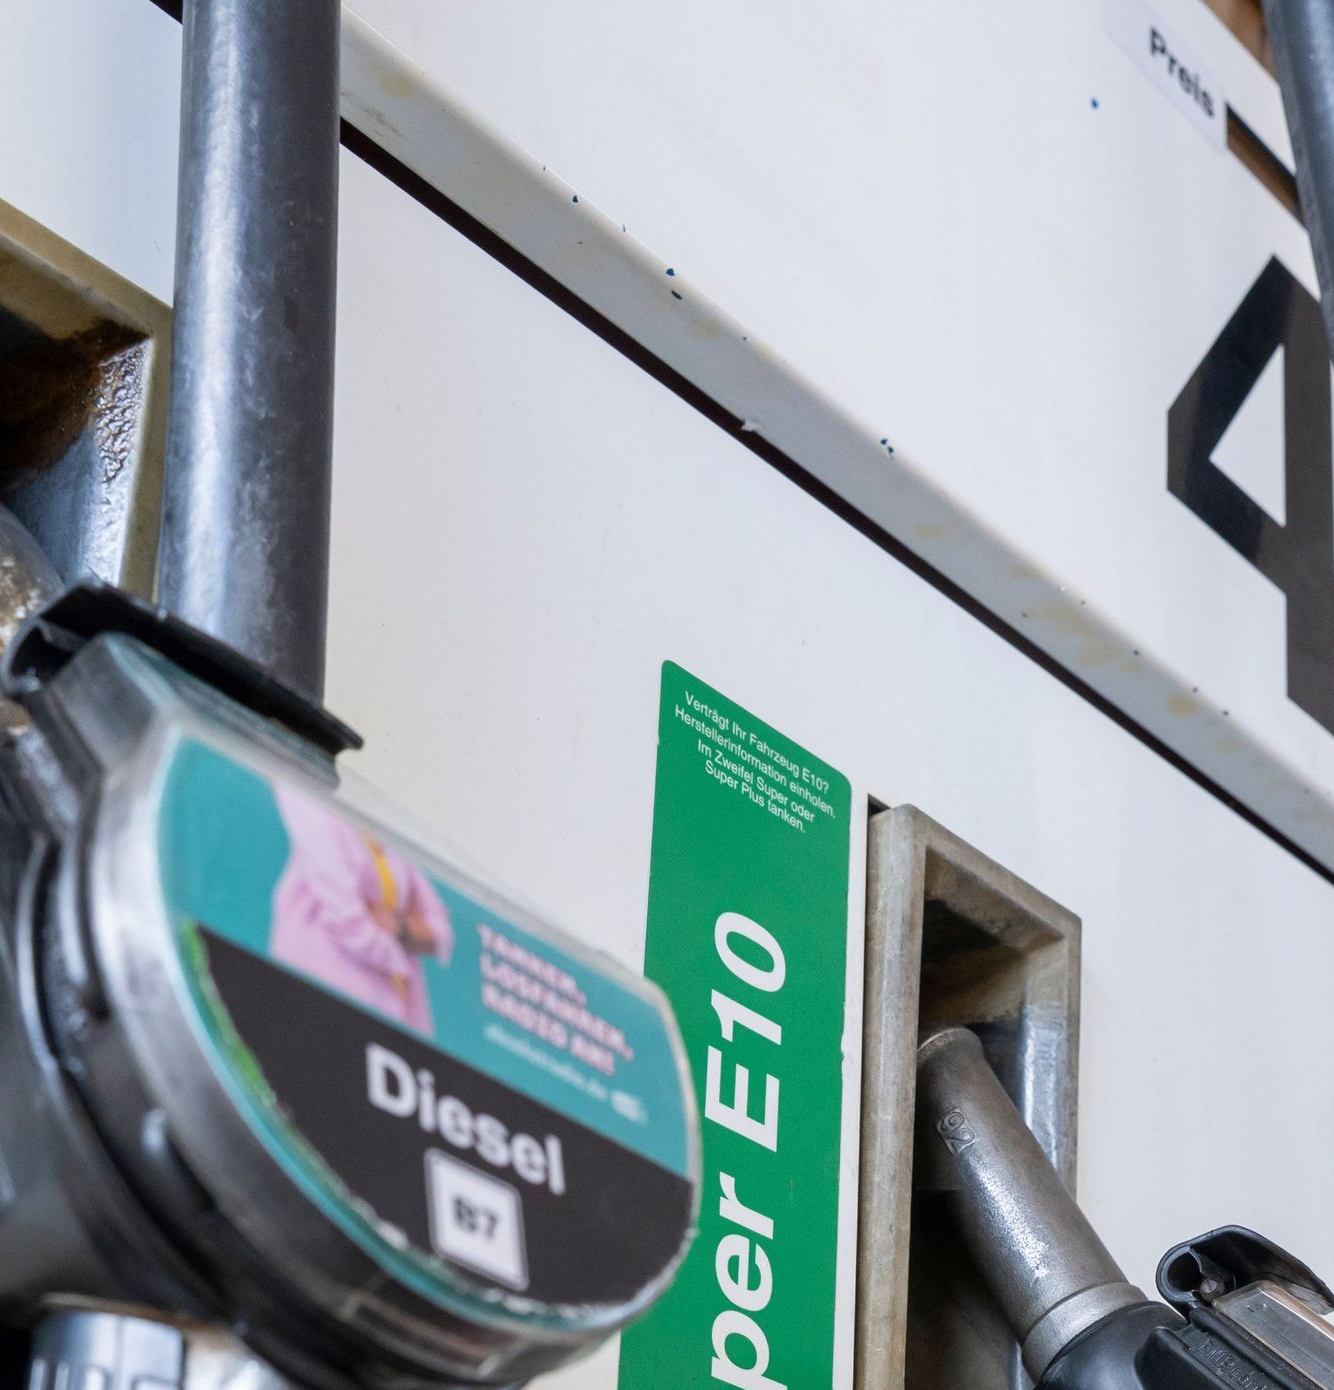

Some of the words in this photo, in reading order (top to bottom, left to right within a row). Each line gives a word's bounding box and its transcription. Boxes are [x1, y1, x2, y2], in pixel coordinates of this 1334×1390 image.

[1149, 26, 1214, 118] Preis
[674, 704, 787, 787] Herstellerinformation
[789, 778, 836, 819] einholen.
[684, 690, 729, 731] Verträgt
[732, 721, 747, 741] Ihr
[749, 733, 800, 779] Fahrzeug
[802, 768, 830, 795] E10?
[697, 739, 712, 758] Im
[714, 749, 754, 785] Zweifel
[756, 777, 789, 808] Super
[790, 800, 816, 824] oder
[704, 760, 739, 791] Super
[741, 782, 765, 808] Plus
[767, 801, 806, 834] tanken.
[703, 911, 787, 1153] E10
[365, 1042, 566, 1196] Diesel
